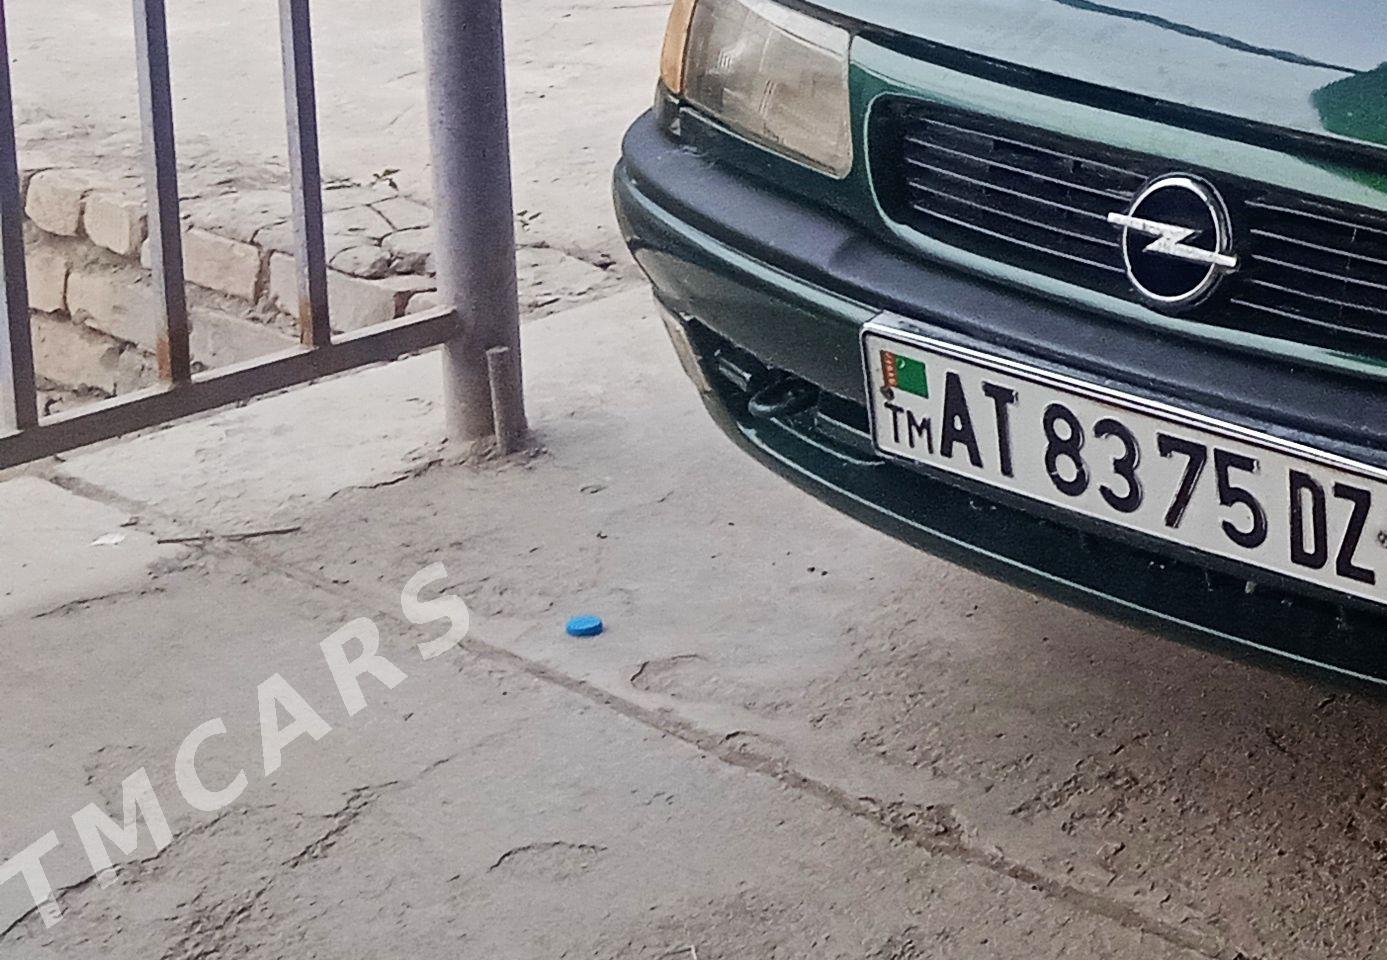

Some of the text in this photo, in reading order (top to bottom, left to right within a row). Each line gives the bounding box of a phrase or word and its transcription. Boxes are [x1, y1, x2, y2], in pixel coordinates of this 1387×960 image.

[884, 401, 935, 454] TM
[940, 371, 1376, 586] AT 8375 DZ
